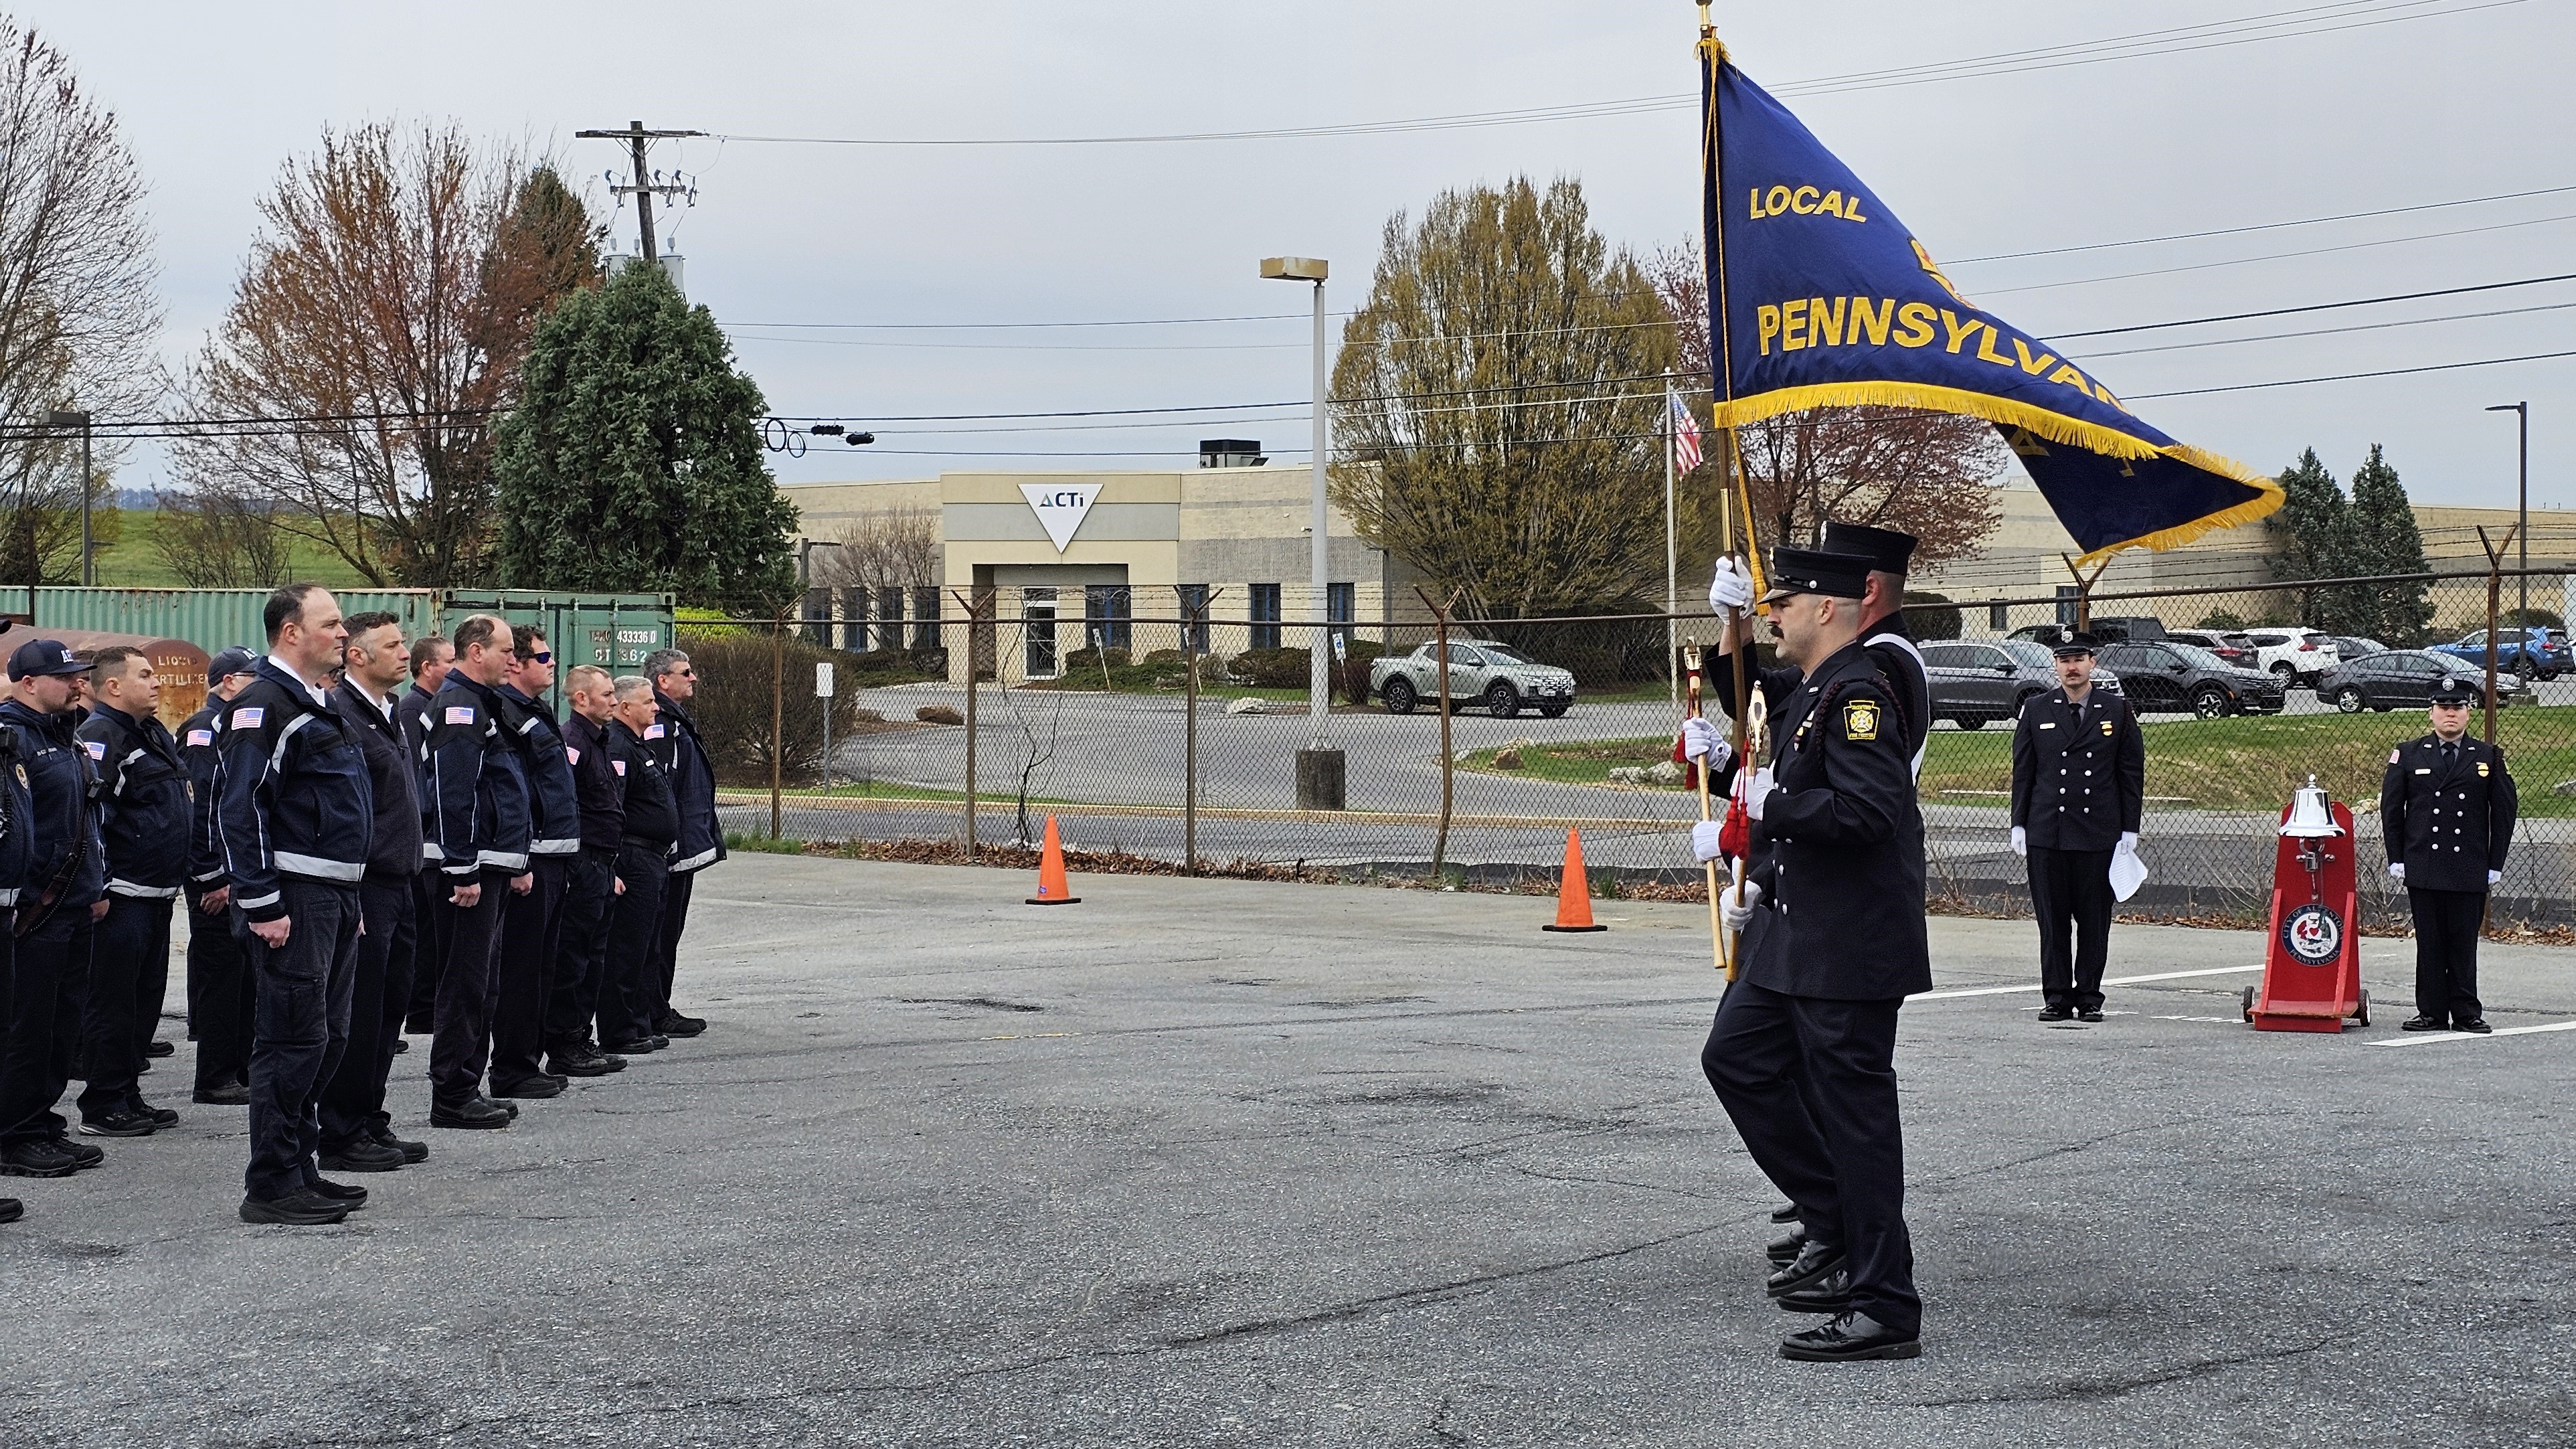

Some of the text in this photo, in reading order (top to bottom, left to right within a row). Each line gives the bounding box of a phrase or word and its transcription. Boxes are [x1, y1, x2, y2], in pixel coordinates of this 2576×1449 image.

[1750, 185, 1868, 224] LOCAL
[616, 630, 649, 643] 433336
[2283, 919, 2292, 939] CITY
